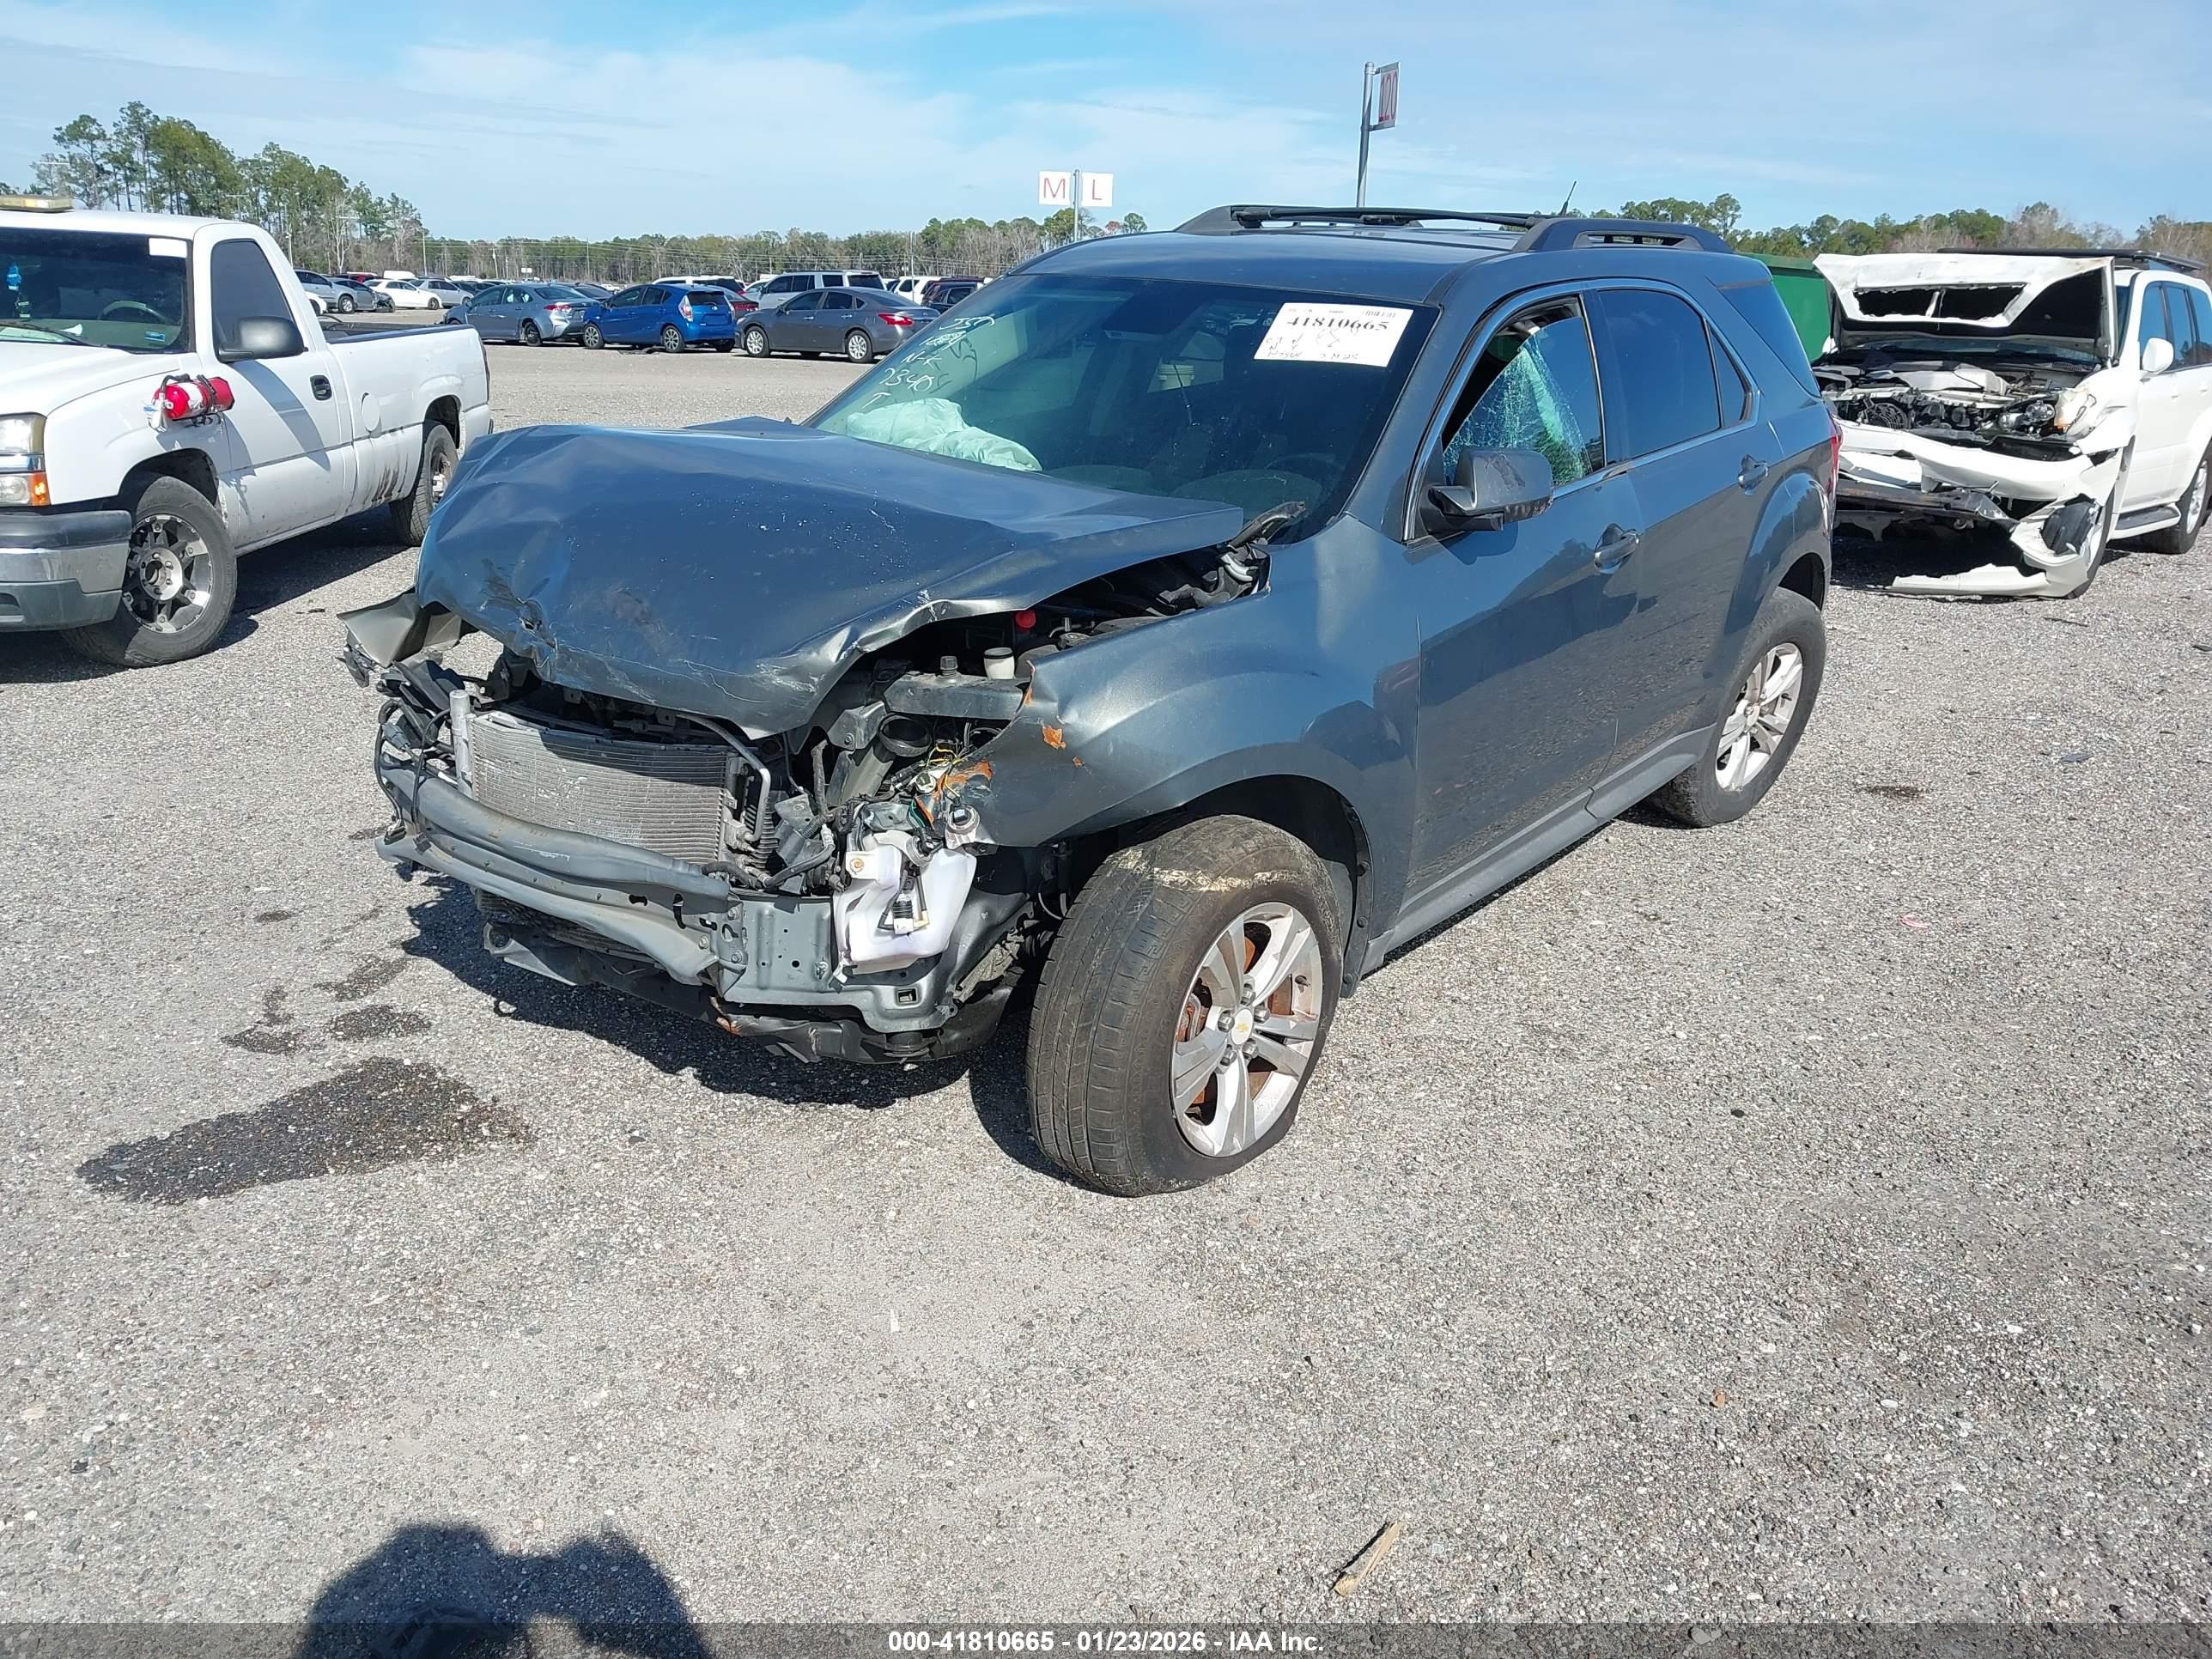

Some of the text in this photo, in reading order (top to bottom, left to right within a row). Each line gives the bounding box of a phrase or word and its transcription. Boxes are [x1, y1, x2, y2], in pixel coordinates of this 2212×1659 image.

[1043, 177, 1066, 199] M
[1091, 179, 1103, 201] L
[1286, 316, 1390, 331] 41810665
